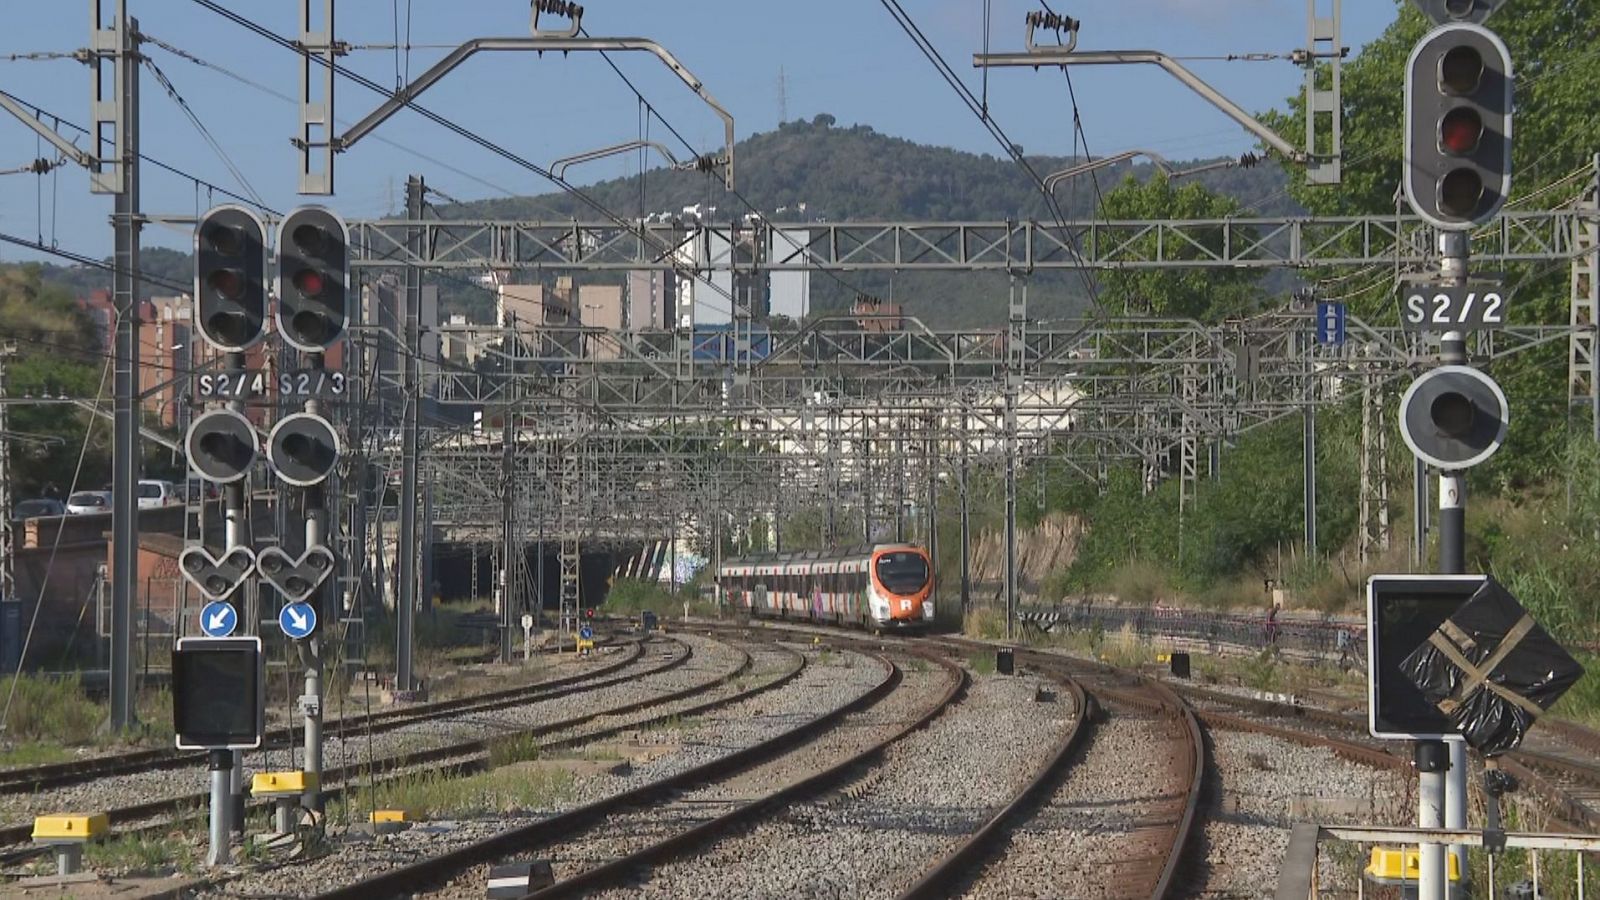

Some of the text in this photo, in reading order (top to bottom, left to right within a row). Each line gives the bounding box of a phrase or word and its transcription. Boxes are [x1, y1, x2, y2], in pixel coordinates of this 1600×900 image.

[1407, 293, 1501, 323] S2/2
[200, 373, 264, 395] S2/4
[280, 372, 345, 394] S2/3
[900, 599, 912, 611] R
